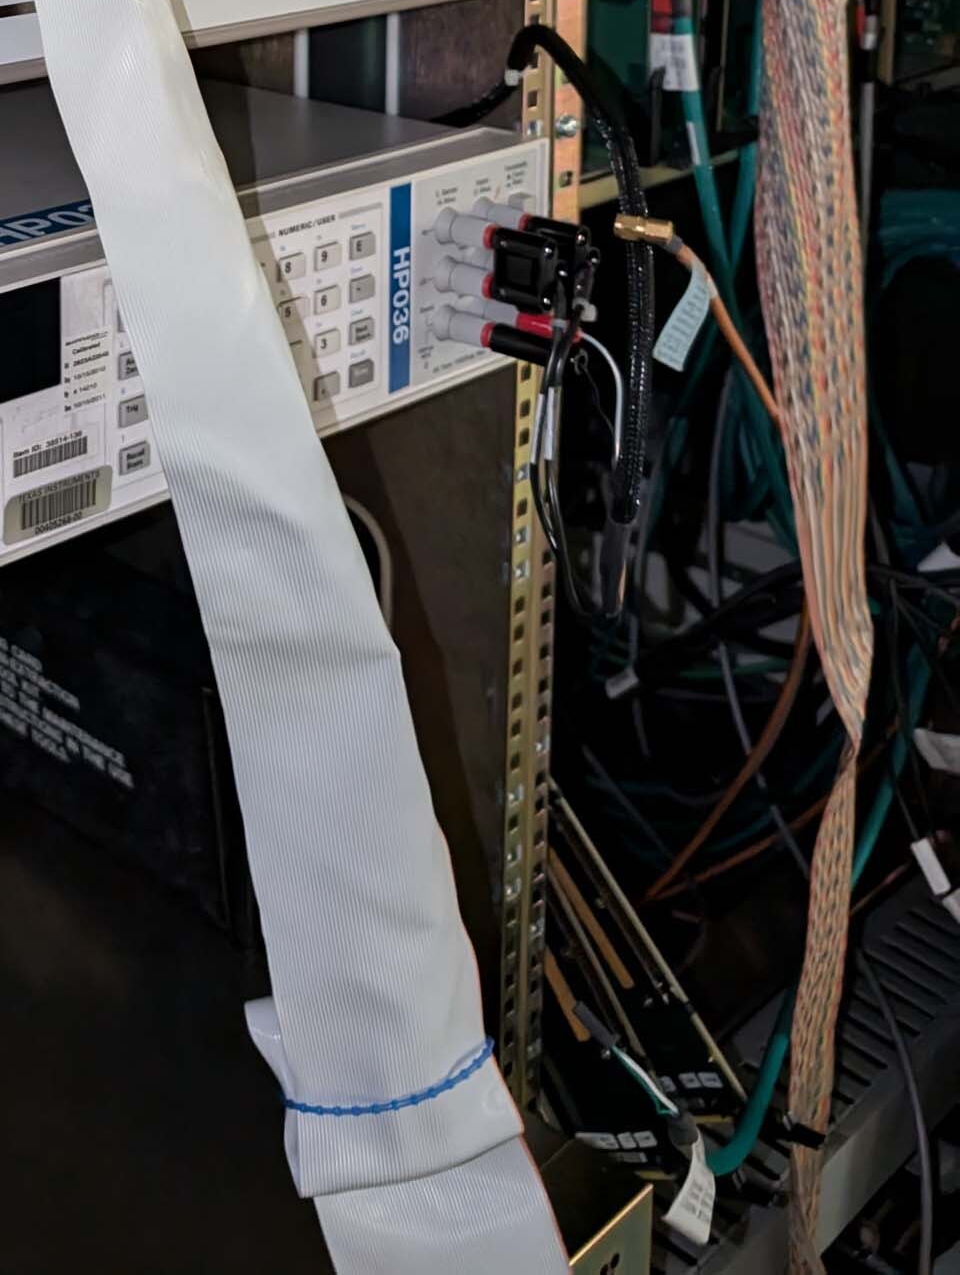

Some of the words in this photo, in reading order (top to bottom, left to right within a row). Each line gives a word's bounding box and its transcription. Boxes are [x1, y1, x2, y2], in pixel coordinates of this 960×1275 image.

[321, 251, 328, 262] 9
[320, 295, 327, 306] 6
[392, 247, 410, 345] HP036
[320, 339, 327, 349] 3
[18, 484, 44, 503] TEXAS
[44, 470, 100, 495] INSTRUMENTS
